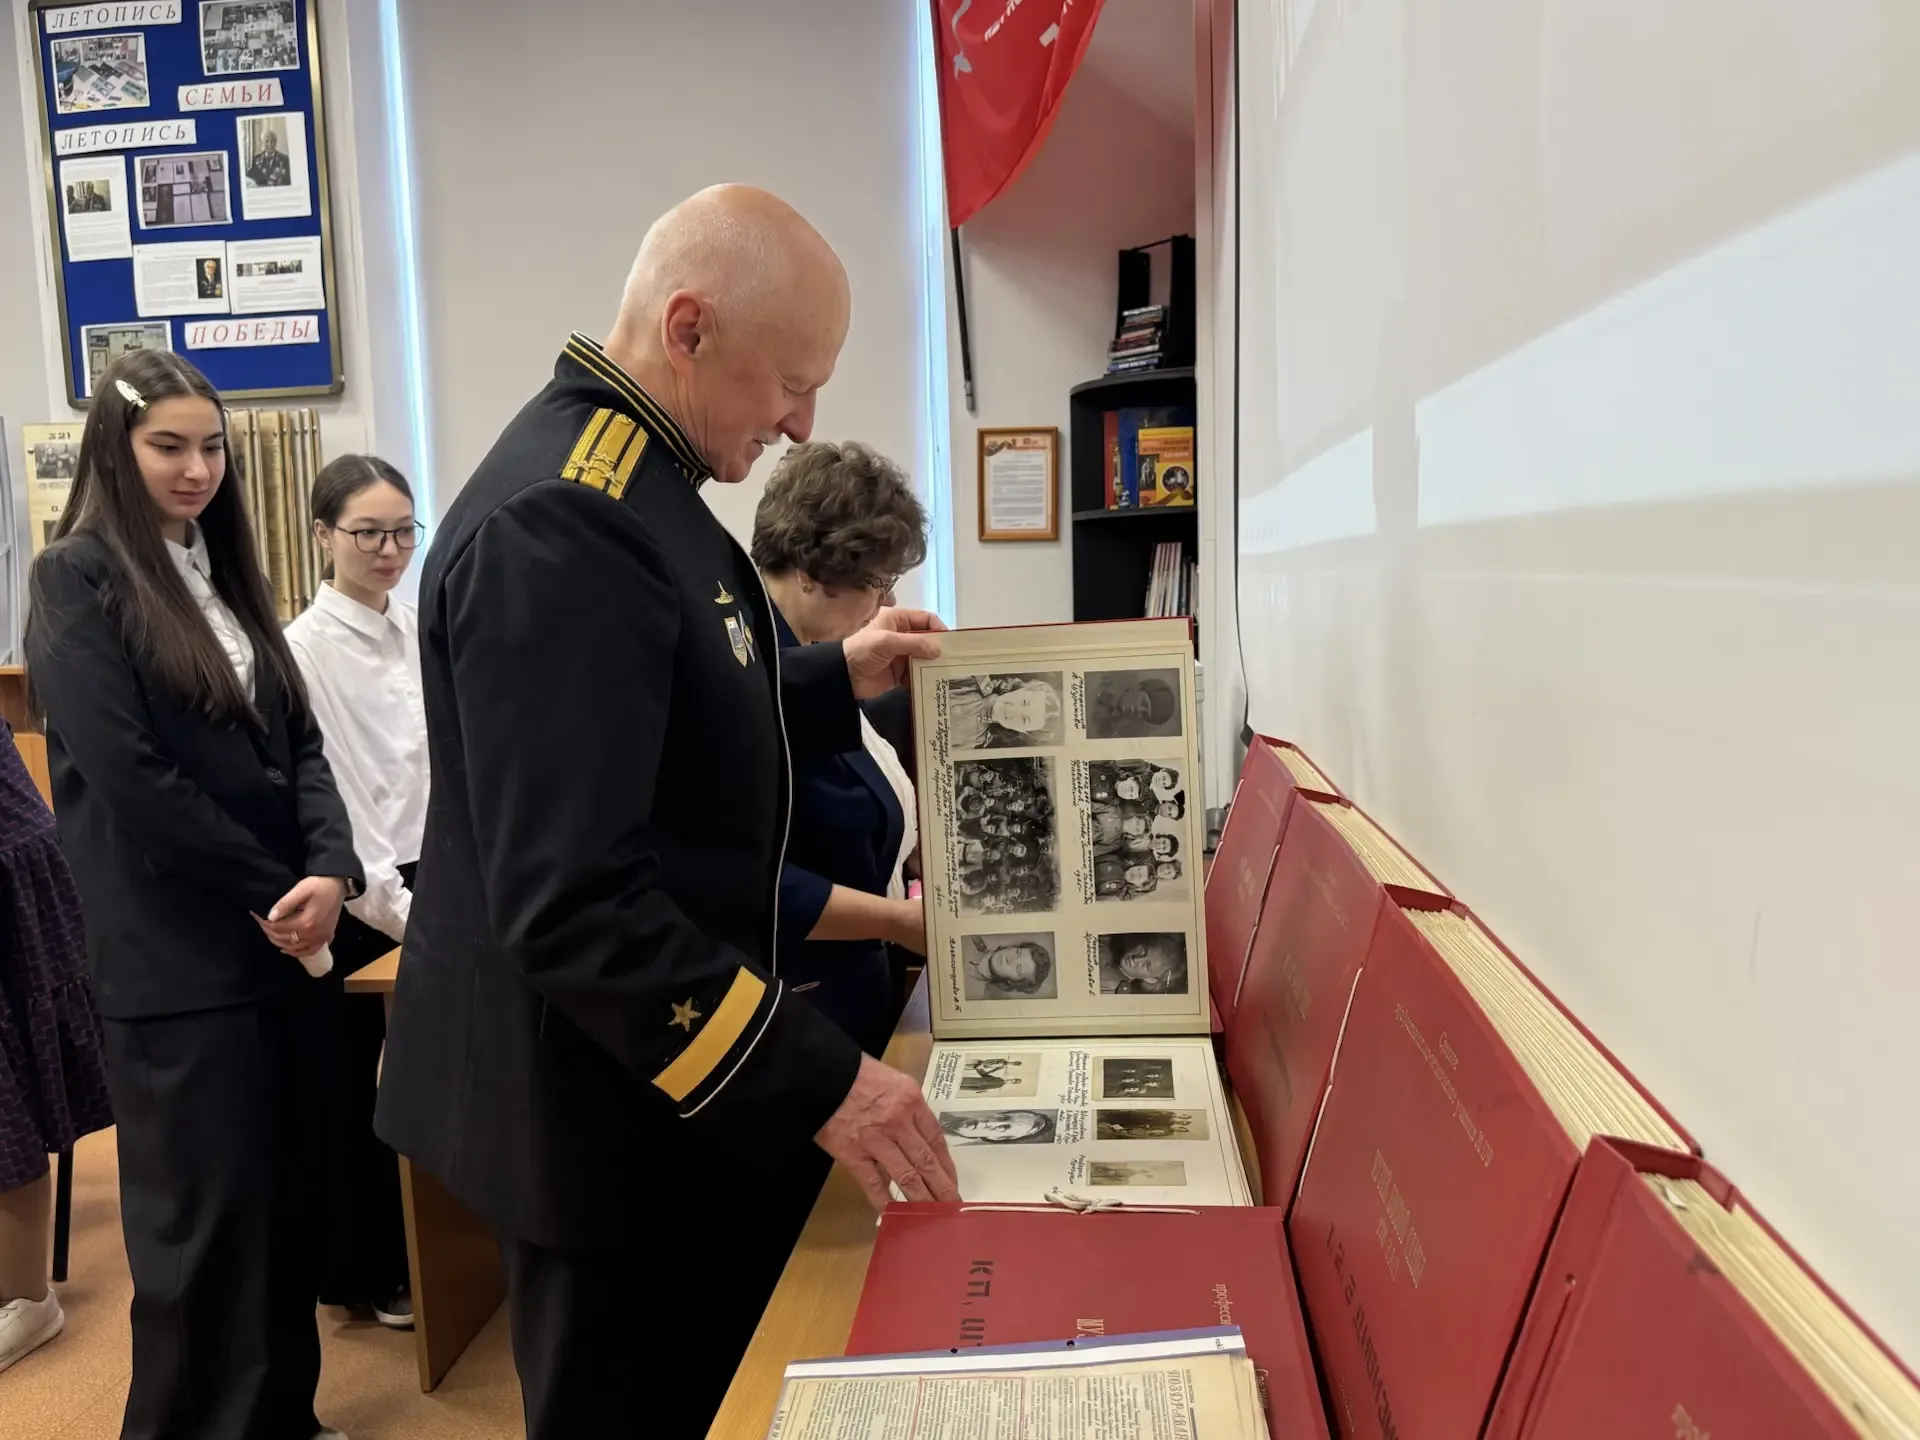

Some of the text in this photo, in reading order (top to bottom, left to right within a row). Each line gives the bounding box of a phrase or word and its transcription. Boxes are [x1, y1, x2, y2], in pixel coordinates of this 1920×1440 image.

[52, 3, 176, 29] ЛЕТОПИСЬ
[185, 83, 273, 106] СЕМЬИ
[61, 125, 186, 150] ЛЕТОПИСЬ
[192, 320, 310, 345] ПОБЕДЫ
[1352, 1303, 1400, 1440] ДИВИЗИ
